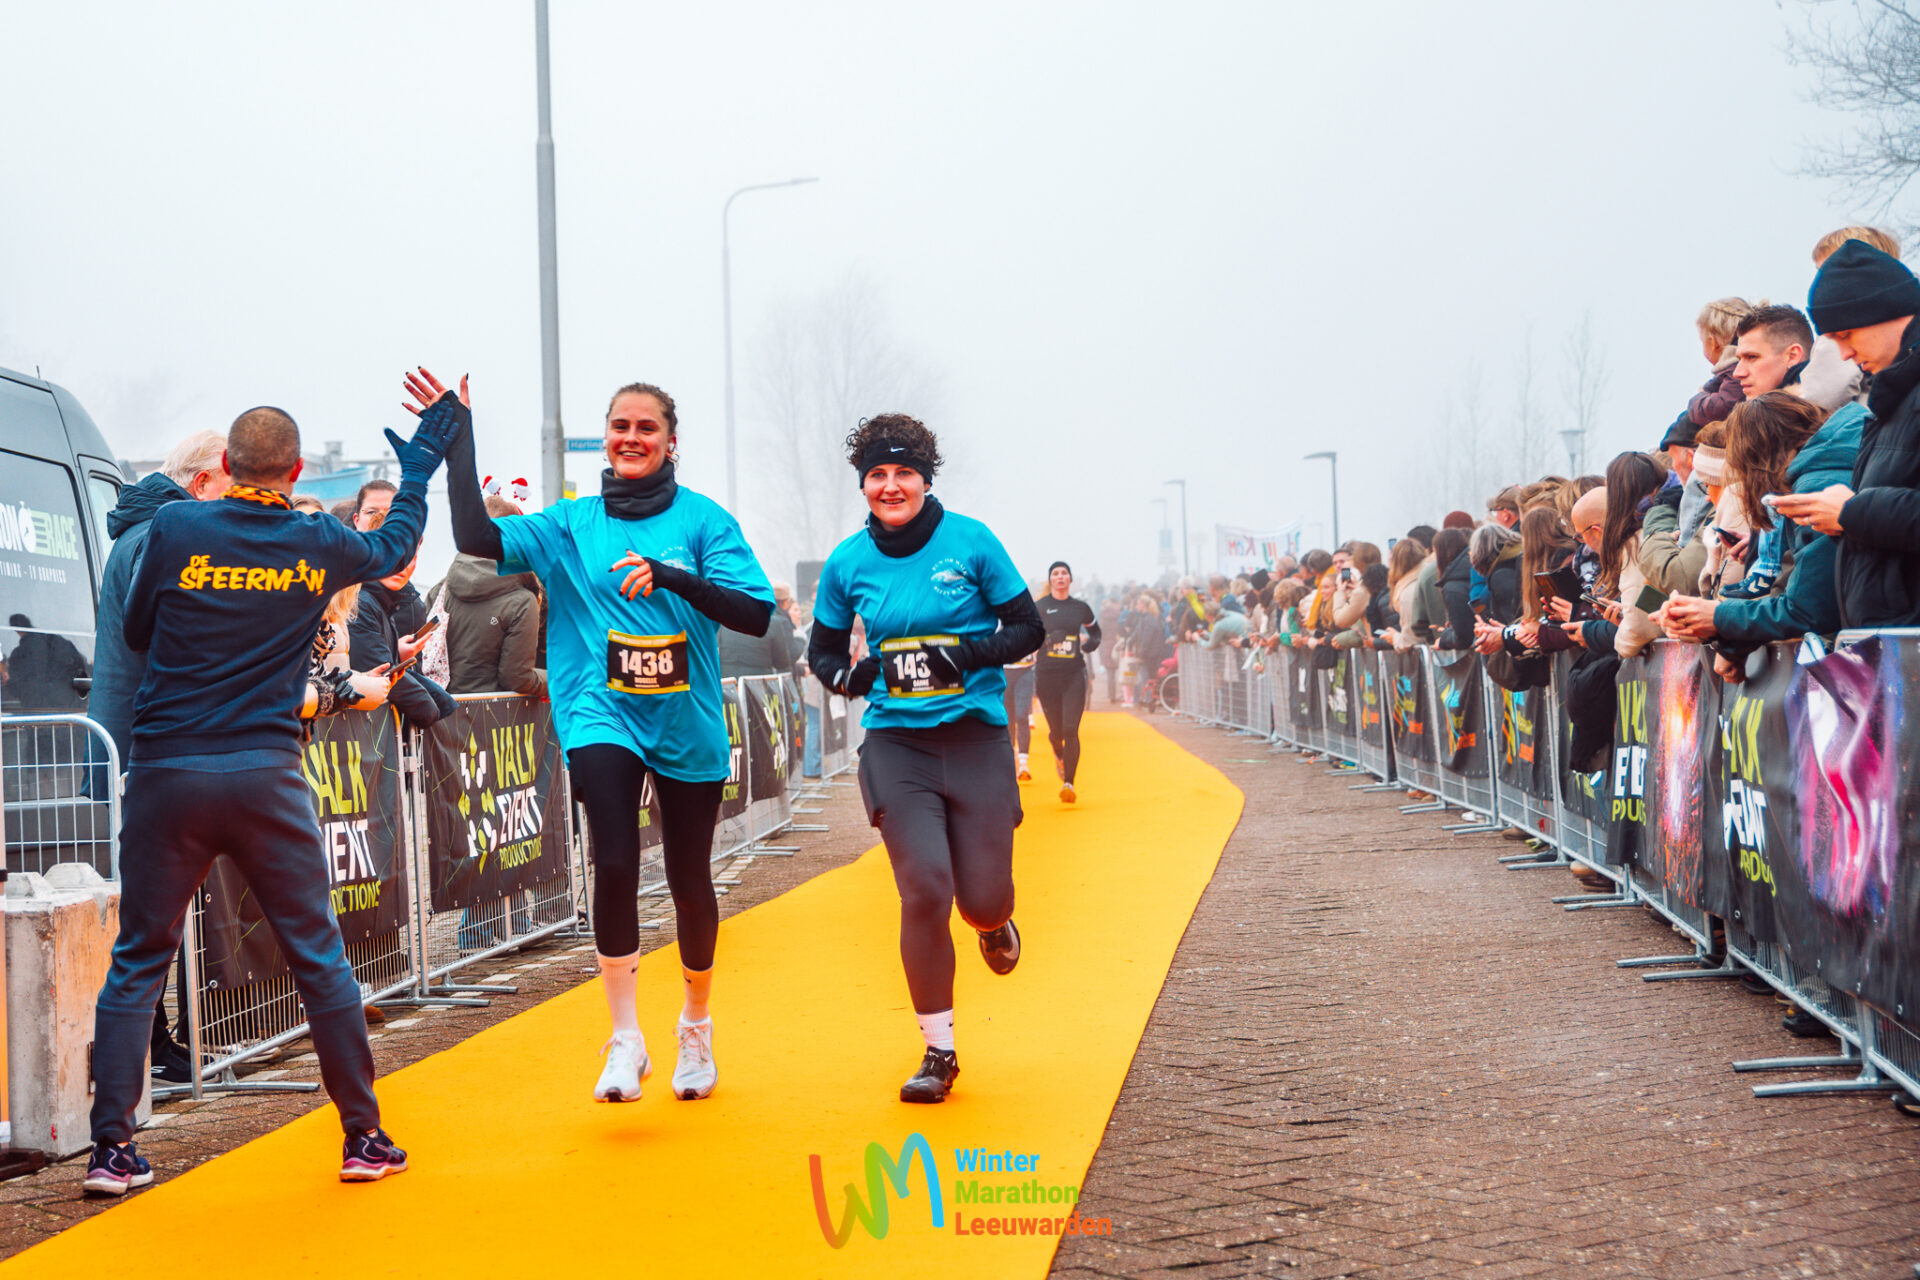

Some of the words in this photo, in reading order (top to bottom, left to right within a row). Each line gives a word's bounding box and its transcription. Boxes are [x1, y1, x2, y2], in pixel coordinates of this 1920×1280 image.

[190, 554, 211, 567] DE
[618, 648, 674, 677] 1438
[893, 652, 931, 680] 143
[491, 722, 536, 789] VALK
[496, 786, 543, 844] EVENT
[499, 835, 542, 871] PRODUCTIONS
